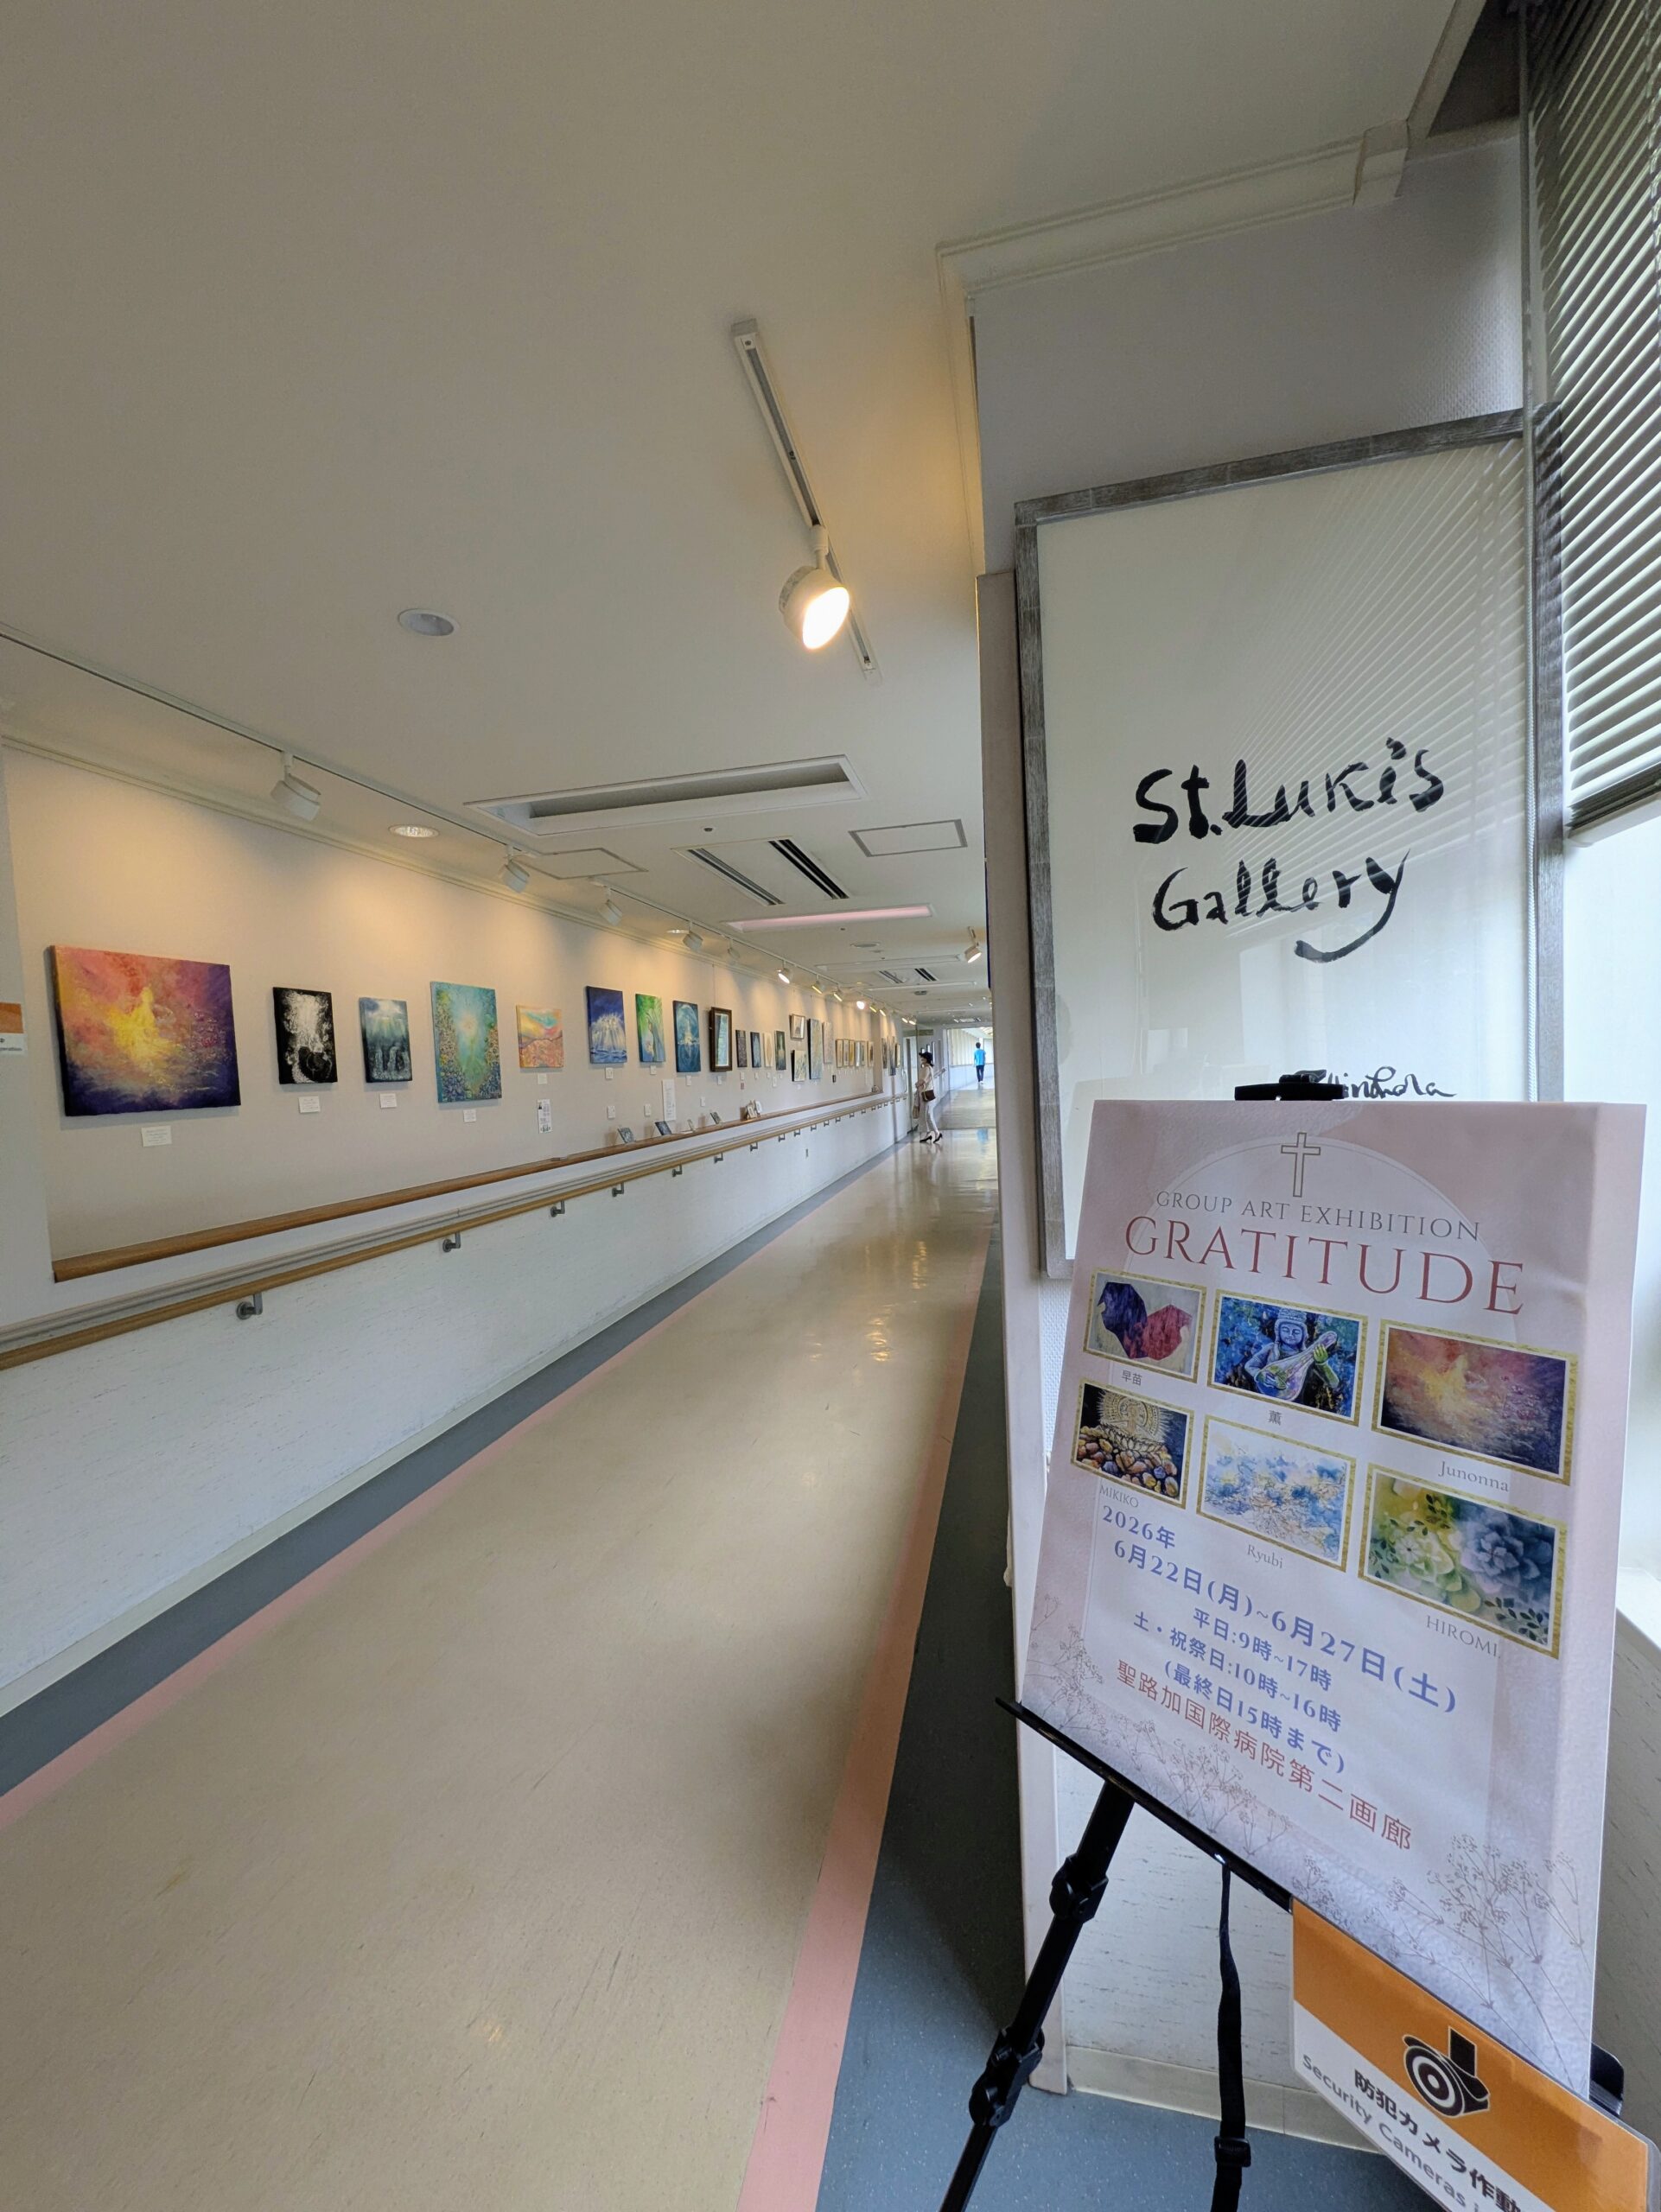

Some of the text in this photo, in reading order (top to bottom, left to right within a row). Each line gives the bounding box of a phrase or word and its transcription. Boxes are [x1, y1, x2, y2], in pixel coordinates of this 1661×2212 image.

[1133, 764, 1222, 844] St.
[1152, 849, 1410, 963] Gallery
[1155, 1190, 1480, 1242] GROUP ART EXHIBITION
[1124, 1215, 1525, 1316] GRATITUDE
[1121, 1369, 1142, 1387] 早苗
[1099, 1484, 1140, 1509] MIKIKO
[1437, 1460, 1509, 1492] Junonna
[1102, 1504, 1177, 1550] 2026年
[1247, 1543, 1284, 1570] Ryubi
[1117, 1658, 1412, 1852] 聖路加国際病院第二画廊
[1302, 2054, 1372, 2126] Security
[1378, 2121, 1467, 2208] Cameras
[1354, 2068, 1521, 2212] 防犯カメラ作動
